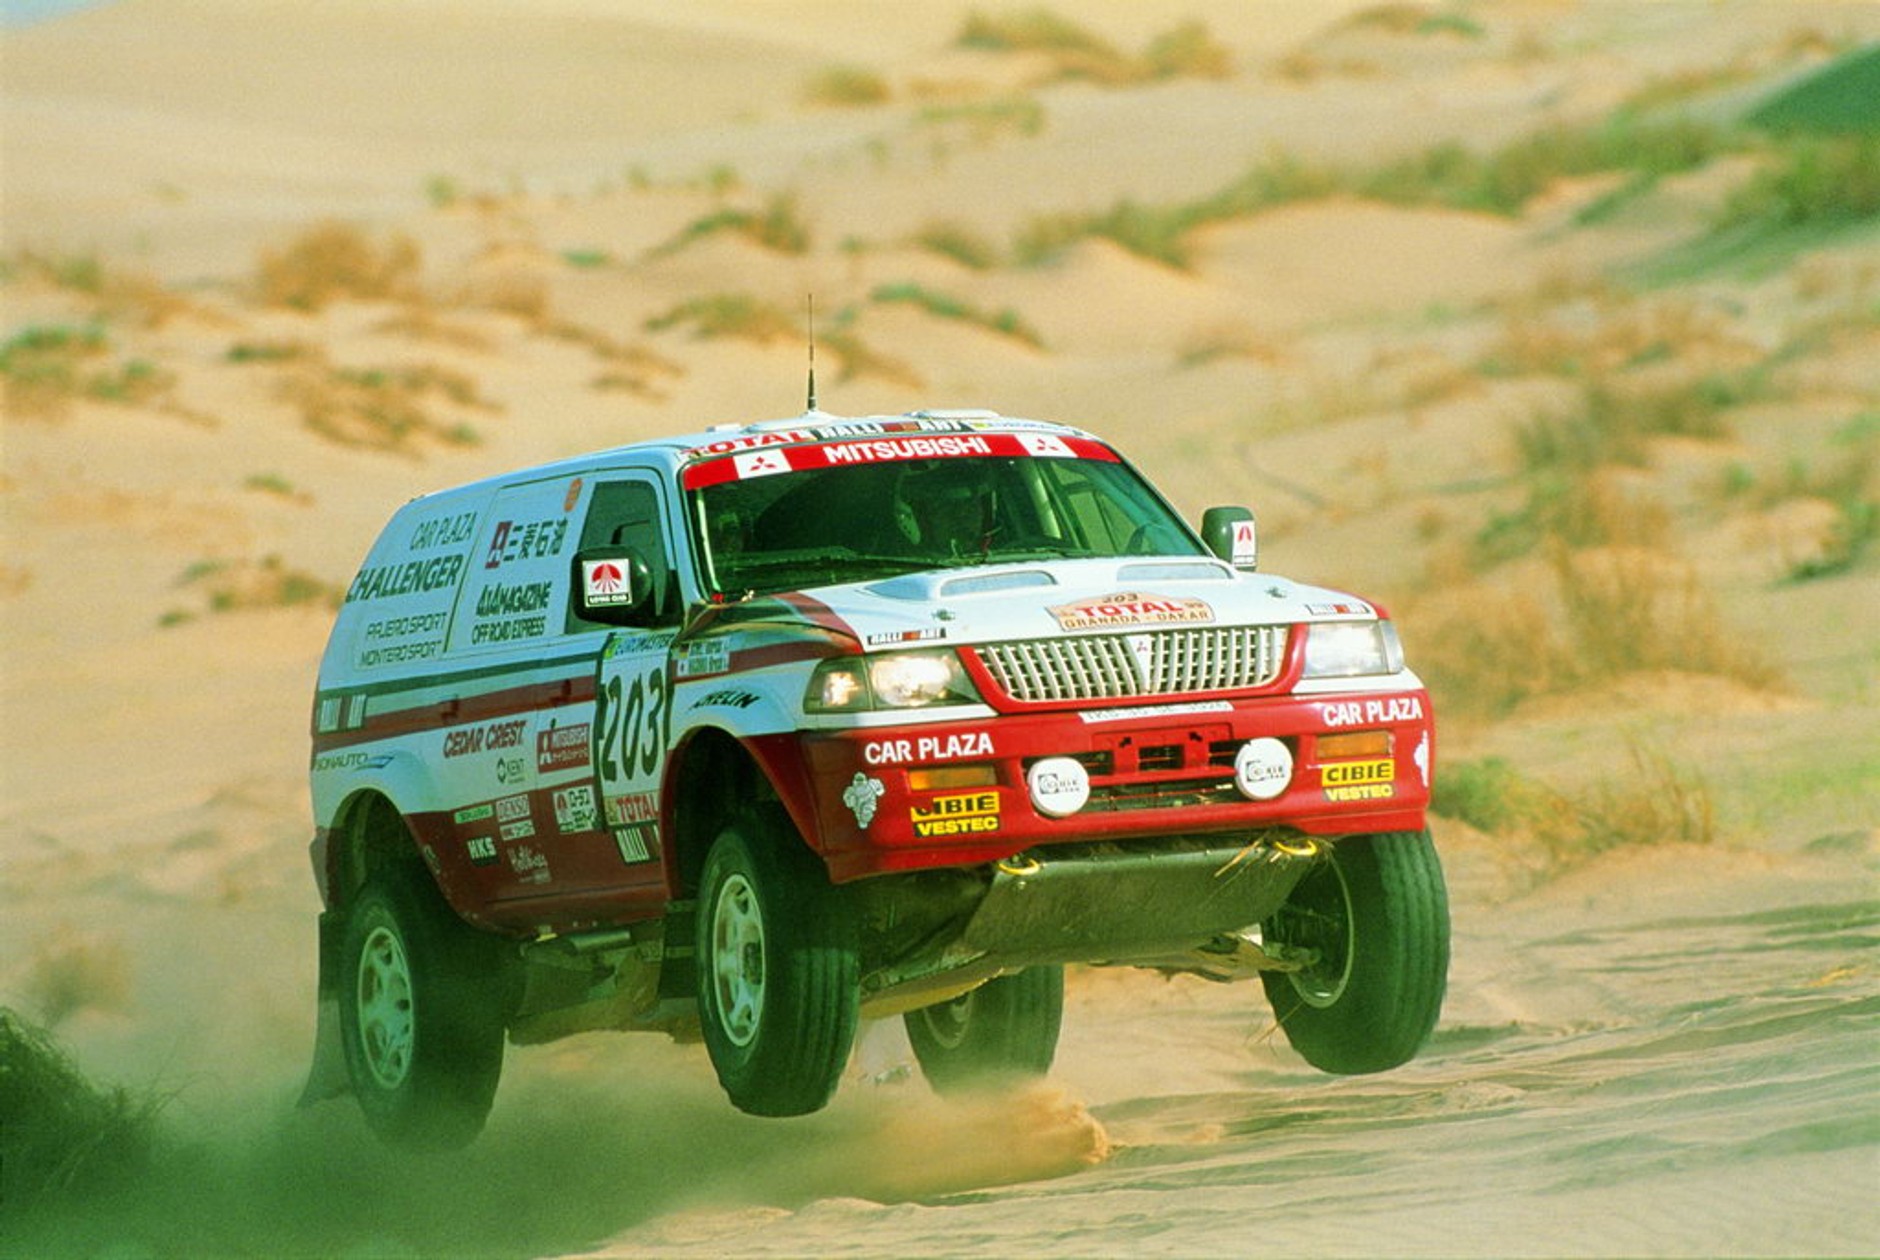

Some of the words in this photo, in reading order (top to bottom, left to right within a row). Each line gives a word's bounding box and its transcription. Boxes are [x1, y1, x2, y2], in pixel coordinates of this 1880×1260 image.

[824, 435, 991, 464] MITSUBISHI
[410, 521, 438, 550] CAR
[437, 512, 477, 548] PLAZA
[346, 554, 463, 603] CHALLENGER
[1075, 602, 1183, 617] TOTAL
[1102, 593, 1139, 604] 203
[407, 611, 447, 635] SPORT
[1064, 615, 1140, 628] GRANADA
[1156, 610, 1208, 621] DAKAR
[402, 640, 442, 662] SPORT
[1322, 703, 1366, 726] CAR
[1368, 698, 1422, 722] PLAZA
[602, 667, 664, 782] 203
[443, 728, 483, 758] CEDAR
[485, 721, 526, 750] CREST
[865, 740, 912, 764] CAR
[918, 732, 994, 759] PLAZA
[1326, 763, 1391, 782] CIBIE
[1325, 785, 1393, 800] VESTEC
[617, 794, 660, 820] TOTAL
[917, 817, 998, 836] VESTEC
[467, 837, 496, 859] HKS
